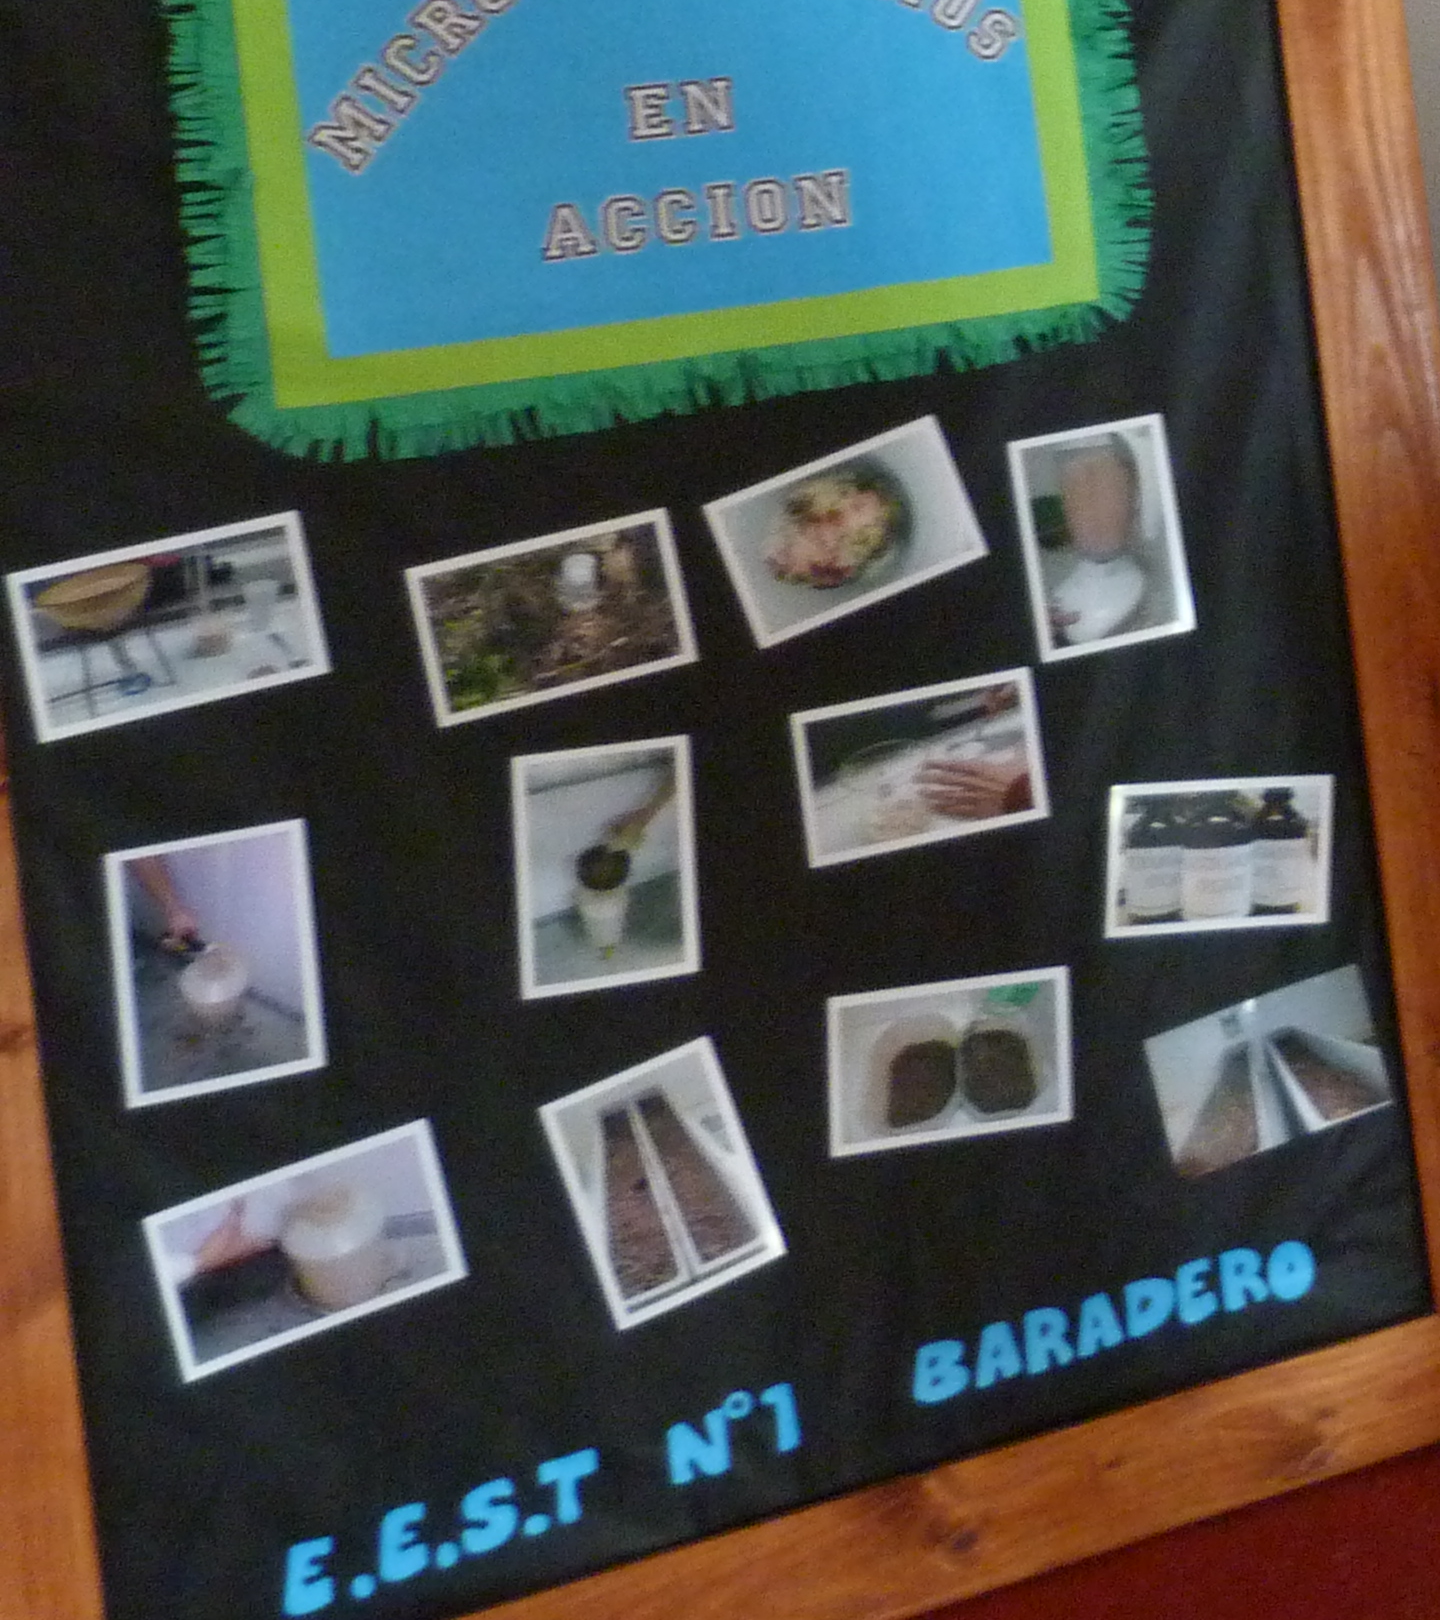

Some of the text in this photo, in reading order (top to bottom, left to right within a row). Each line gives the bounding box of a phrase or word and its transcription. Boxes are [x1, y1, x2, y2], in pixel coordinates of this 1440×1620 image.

[623, 75, 737, 144] EN
[541, 168, 853, 264] ACCION
[281, 1446, 601, 1619] E.E.S.T
[911, 1239, 1318, 1406] BARADERO
